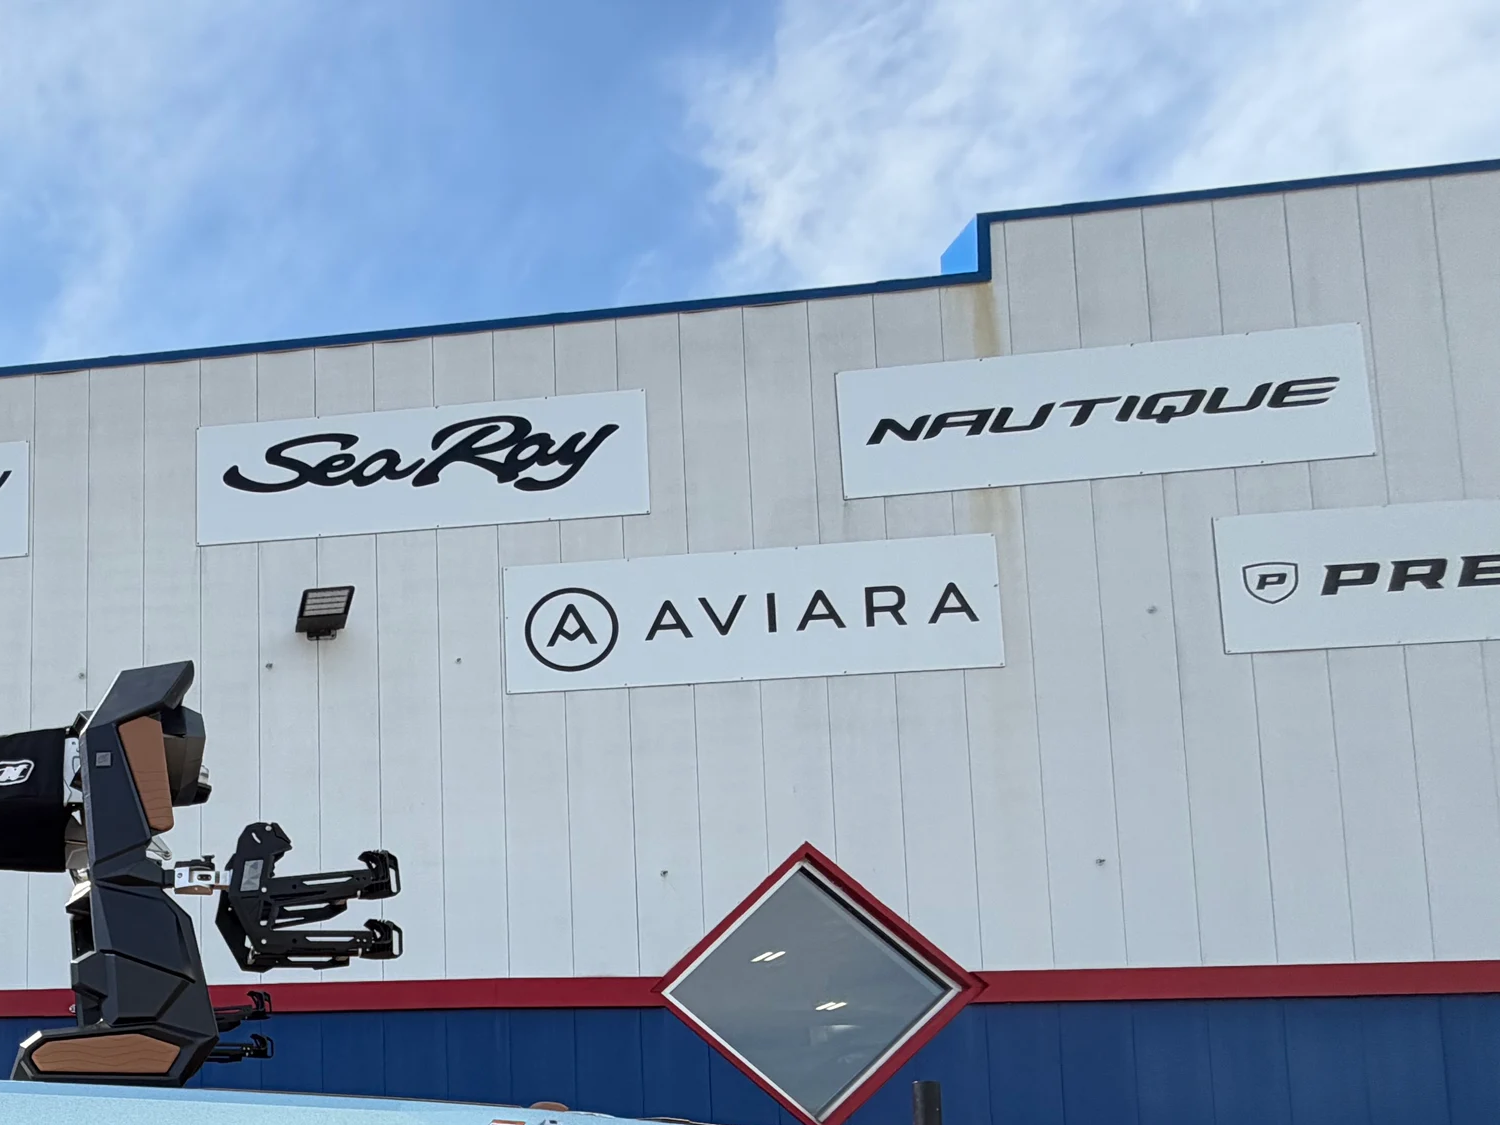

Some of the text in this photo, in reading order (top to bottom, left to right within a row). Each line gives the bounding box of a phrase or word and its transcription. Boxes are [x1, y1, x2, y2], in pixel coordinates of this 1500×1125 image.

[866, 376, 1340, 446] NAUTIQUE
[222, 415, 620, 493] Sea Ray
[1320, 553, 1500, 596] PRE
[644, 581, 980, 641] AVIARA
